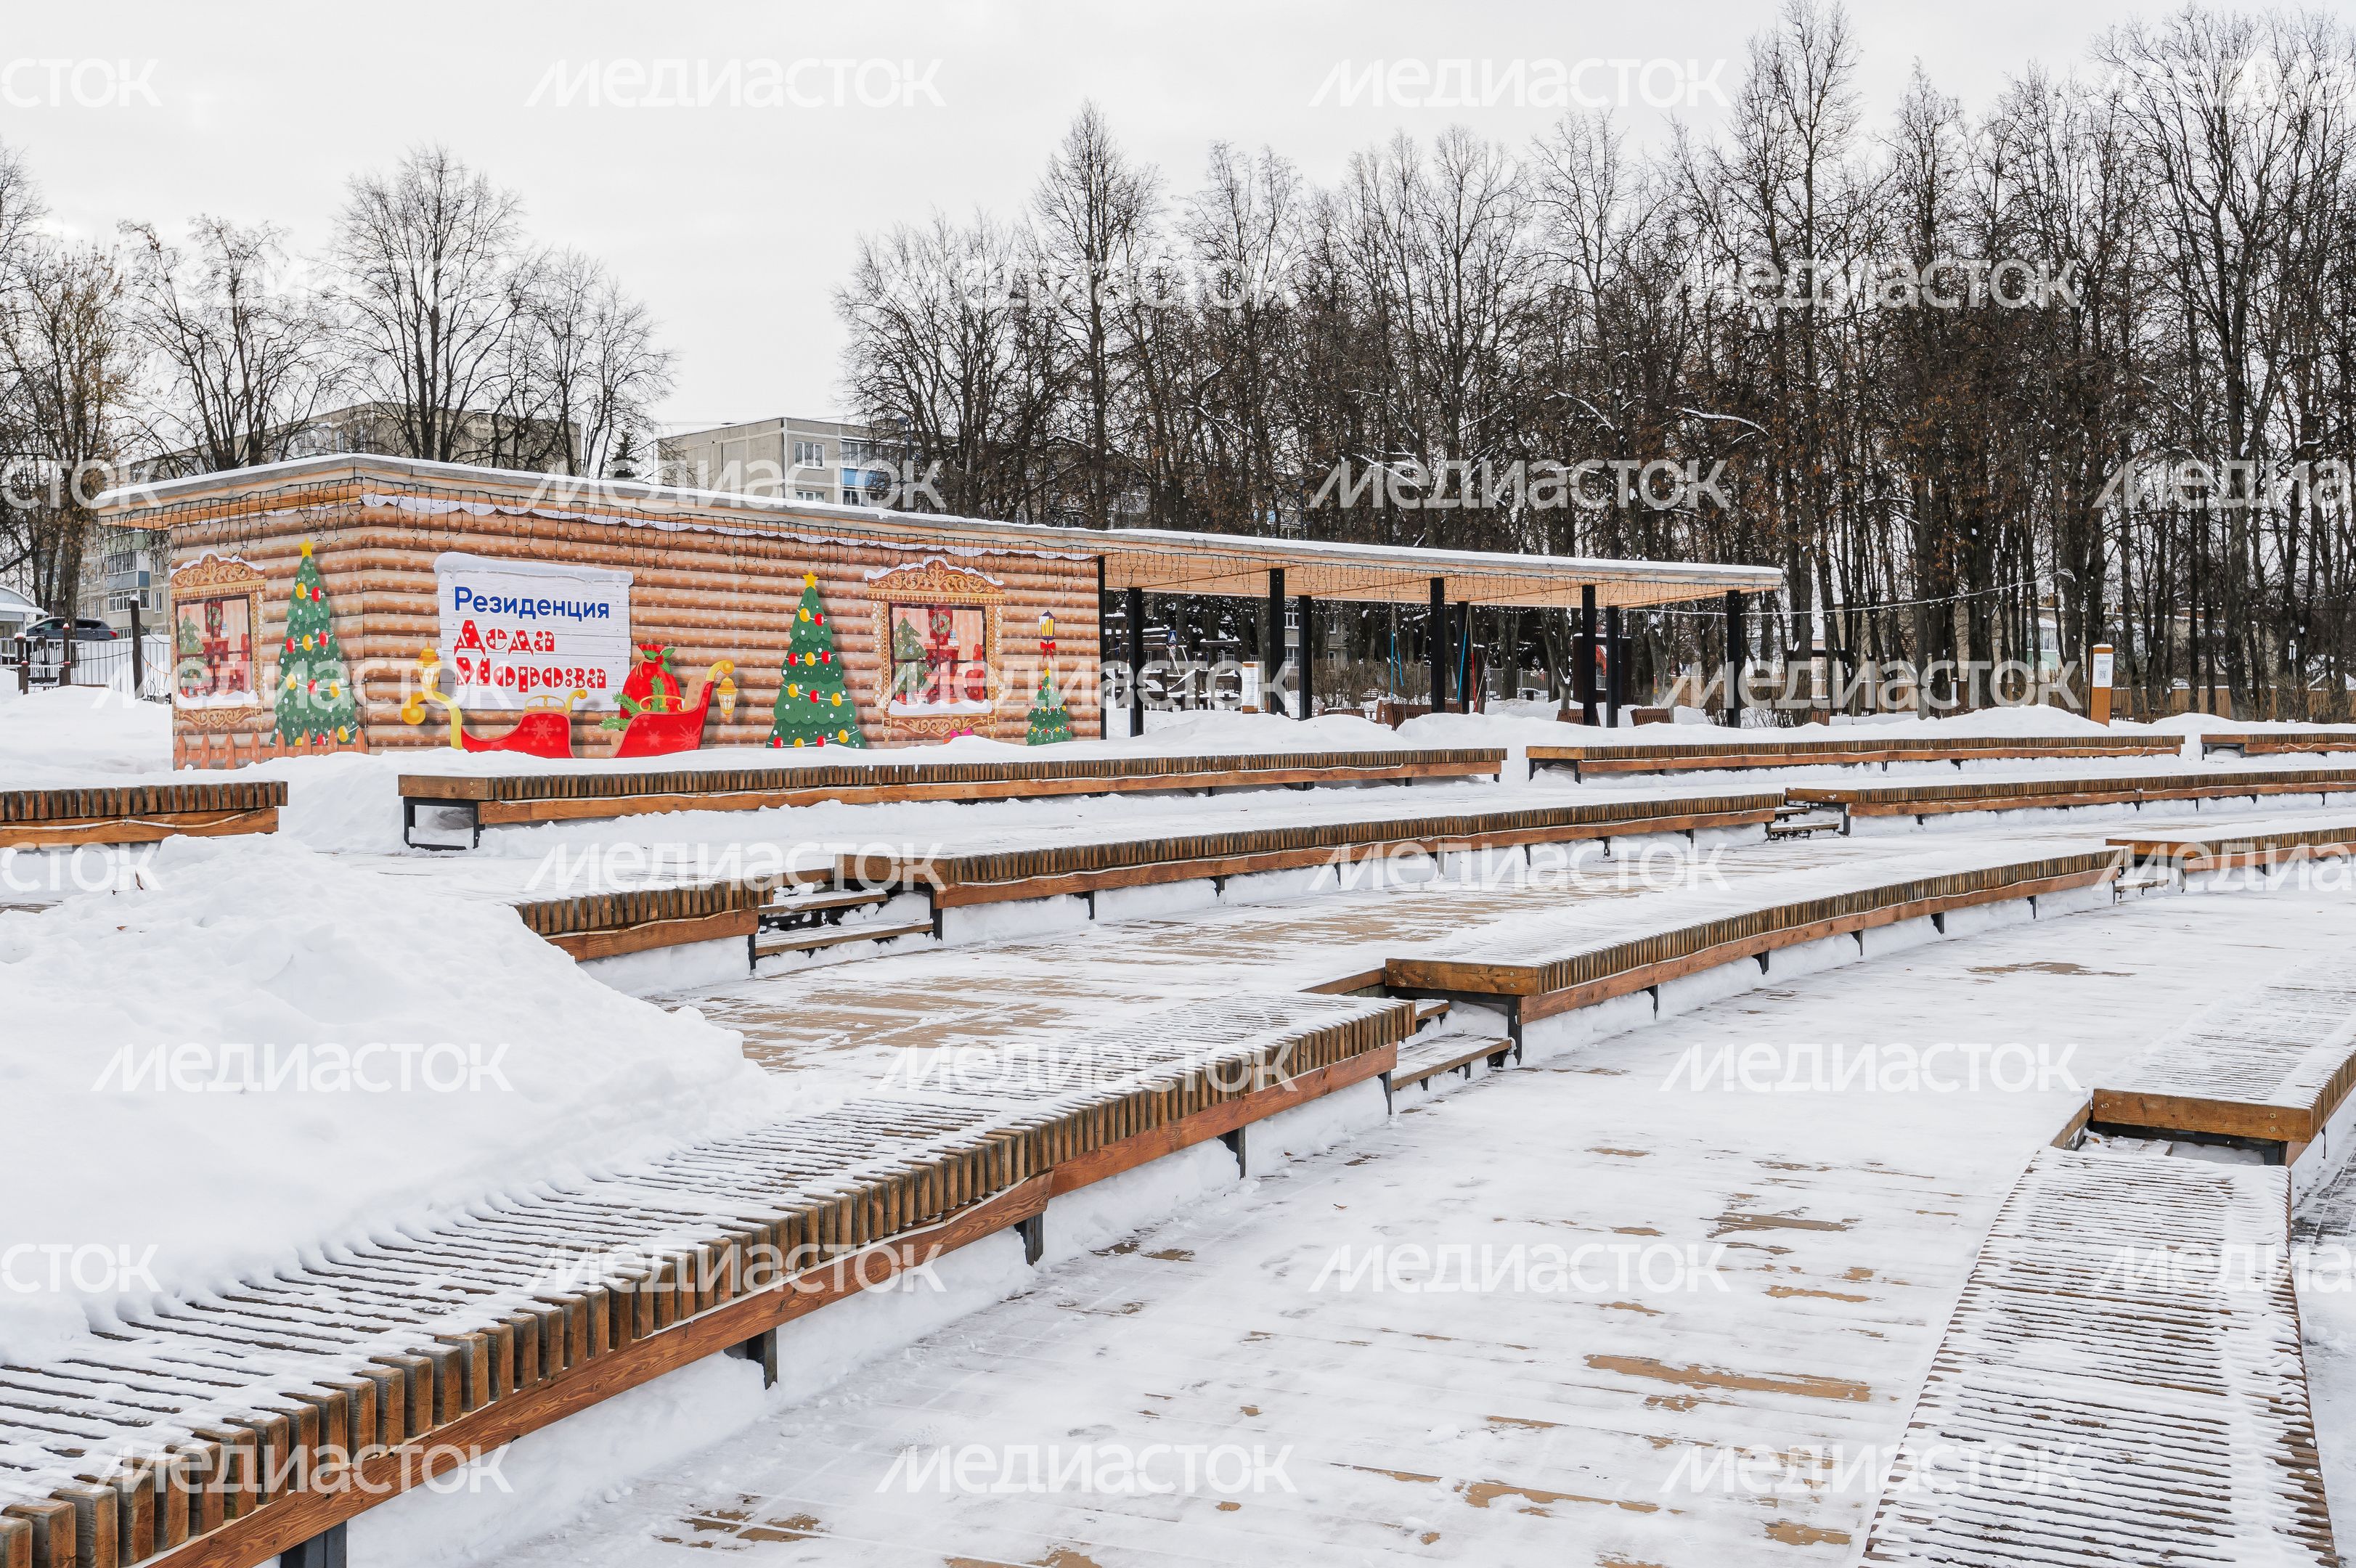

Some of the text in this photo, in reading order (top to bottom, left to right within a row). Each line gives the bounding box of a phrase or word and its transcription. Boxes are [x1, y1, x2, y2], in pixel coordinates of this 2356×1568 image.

[455, 586, 609, 622] Резиденция
[454, 619, 555, 656] Деда
[456, 657, 606, 693] Мороза
